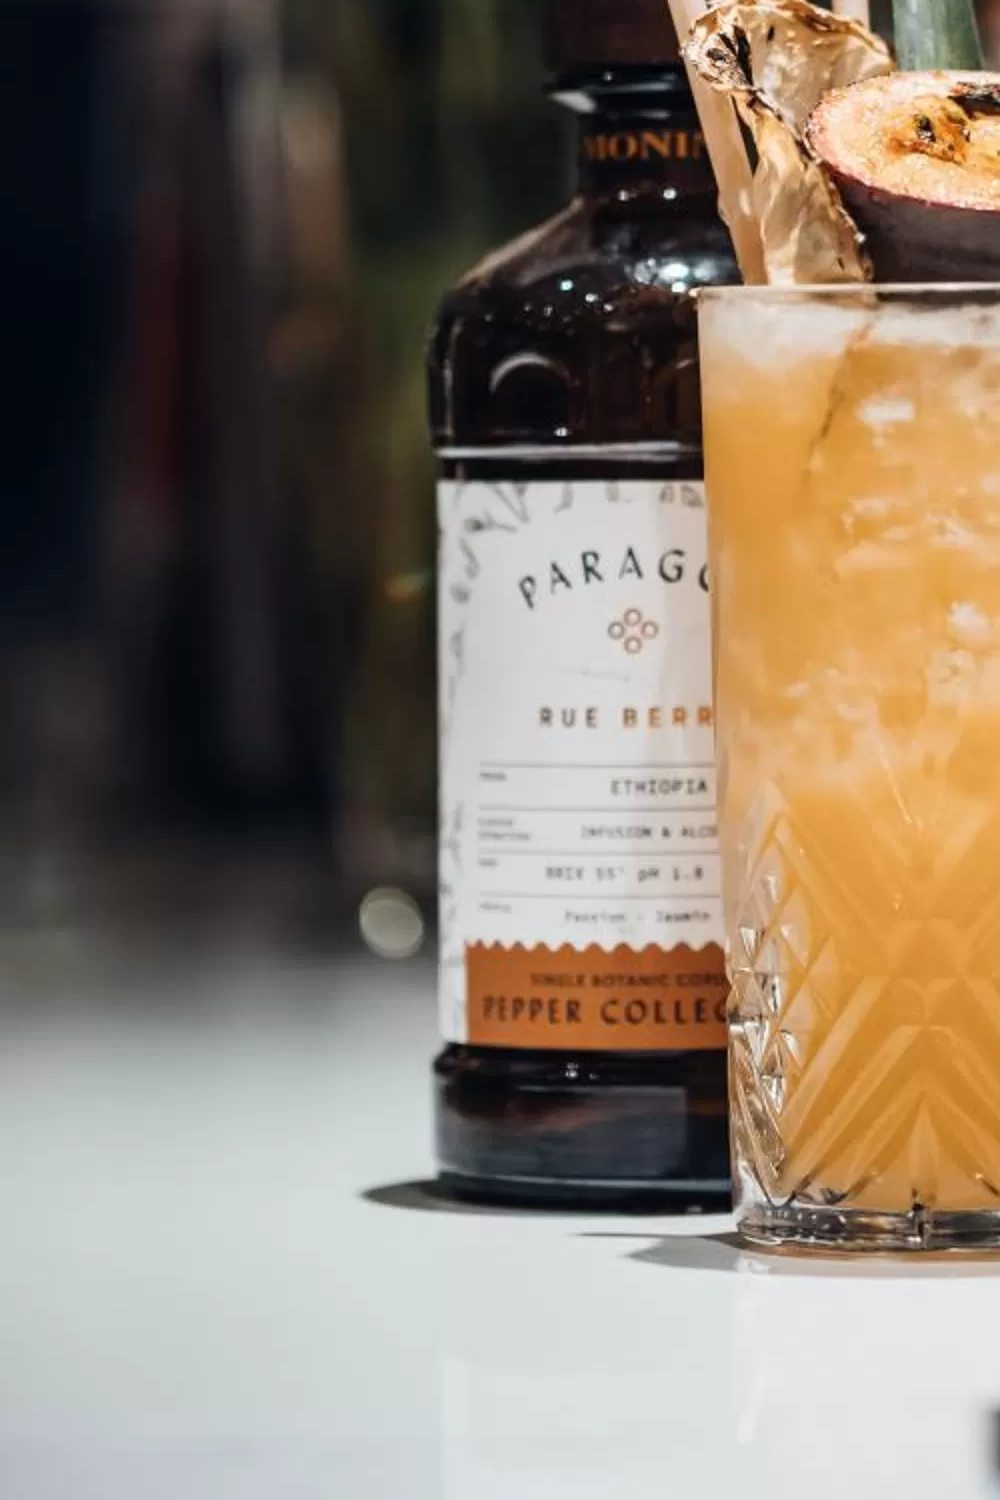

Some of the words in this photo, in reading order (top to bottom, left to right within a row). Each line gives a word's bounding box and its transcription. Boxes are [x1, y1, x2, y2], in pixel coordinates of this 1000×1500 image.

[540, 707, 599, 728] RUE
[610, 779, 708, 796] ETHIOPIA
[482, 995, 581, 1025] PEPPER
